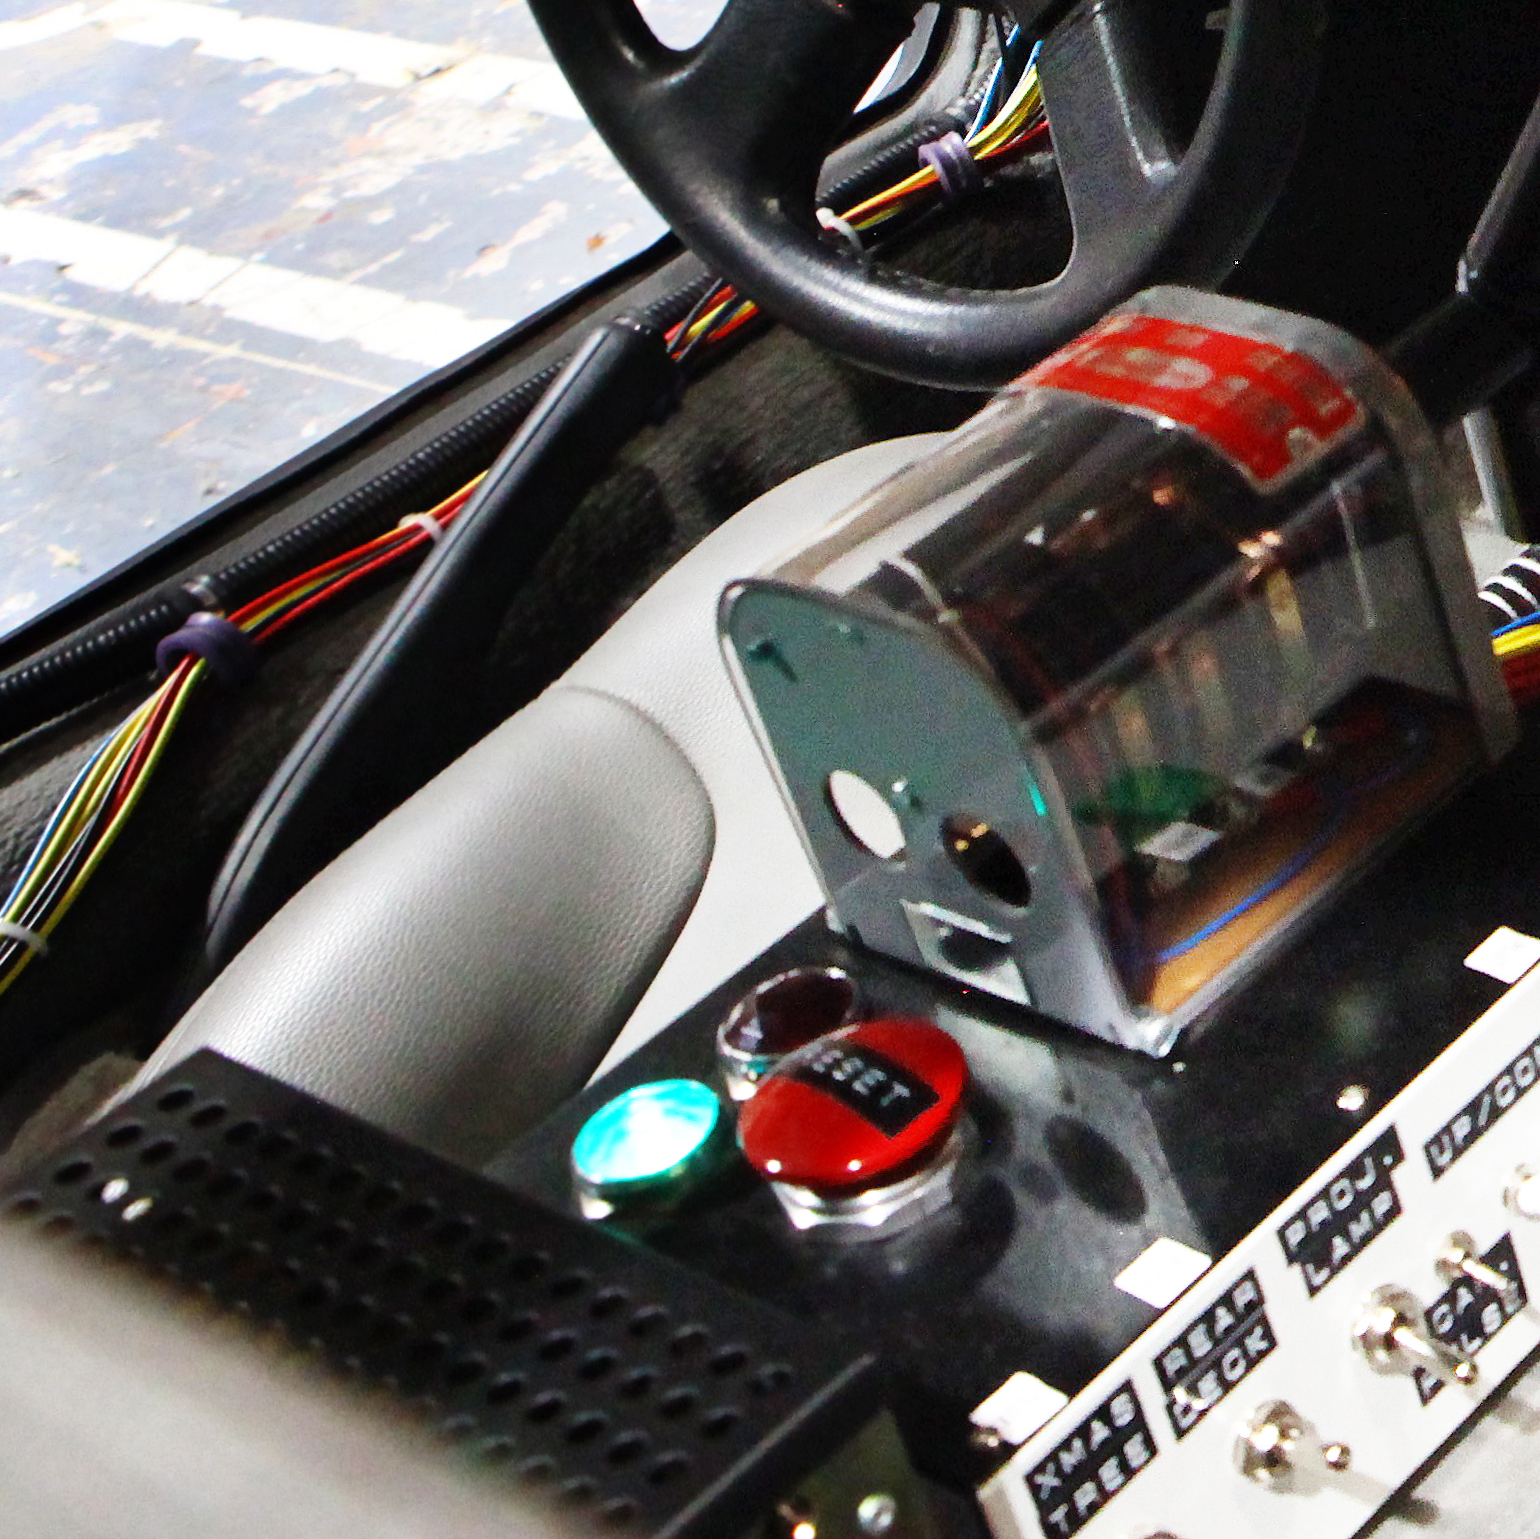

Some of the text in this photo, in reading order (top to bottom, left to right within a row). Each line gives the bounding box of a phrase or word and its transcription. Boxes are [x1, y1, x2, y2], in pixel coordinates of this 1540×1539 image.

[1284, 1154, 1394, 1253] PROJ.
[1305, 1190, 1394, 1287] LAMP
[1161, 1279, 1258, 1379] REAR
[1172, 1325, 1271, 1430] DECK
[1033, 1392, 1137, 1500] XMAS
[1048, 1431, 1150, 1535] TREE
